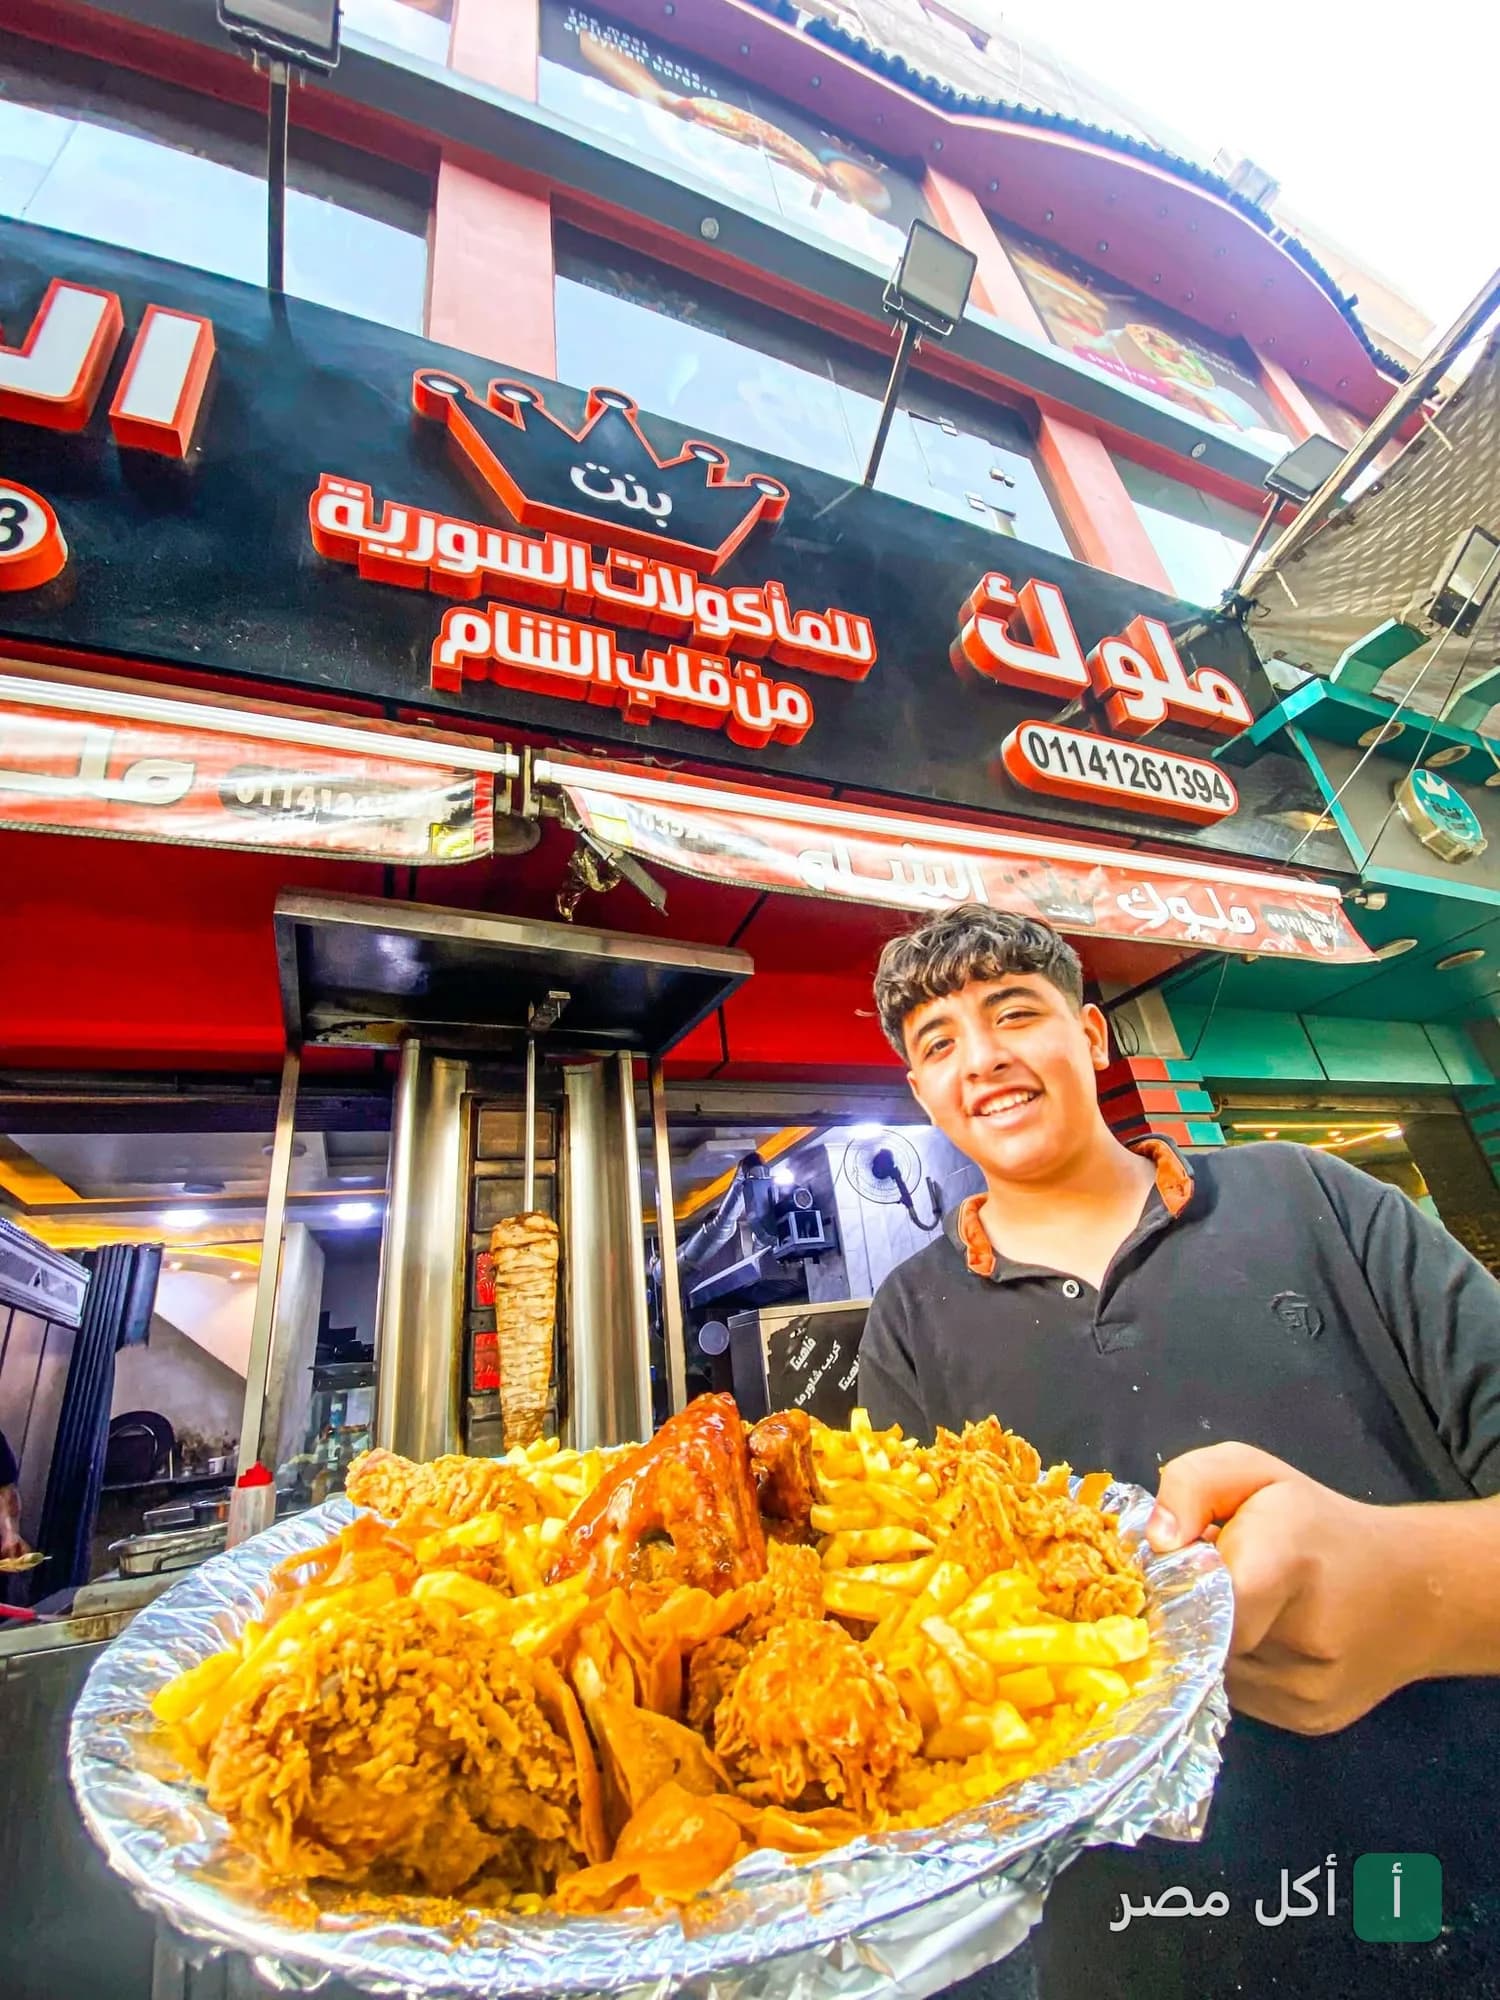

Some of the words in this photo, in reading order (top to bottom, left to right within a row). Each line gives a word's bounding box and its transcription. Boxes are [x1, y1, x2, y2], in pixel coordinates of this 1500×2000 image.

[0, 283, 203, 428] ال
[569, 461, 673, 529] بنت
[314, 478, 591, 595] السورية
[589, 552, 875, 663] للمأكولات
[437, 608, 615, 684] الشام
[614, 650, 733, 708] قلب
[974, 573, 1254, 725] ملوك
[733, 665, 811, 729] من
[1027, 731, 1231, 807] 01141261394
[1115, 881, 1257, 936] ملوك
[794, 1369, 824, 1406] شاورما
[838, 1354, 861, 1392] اهيتا
